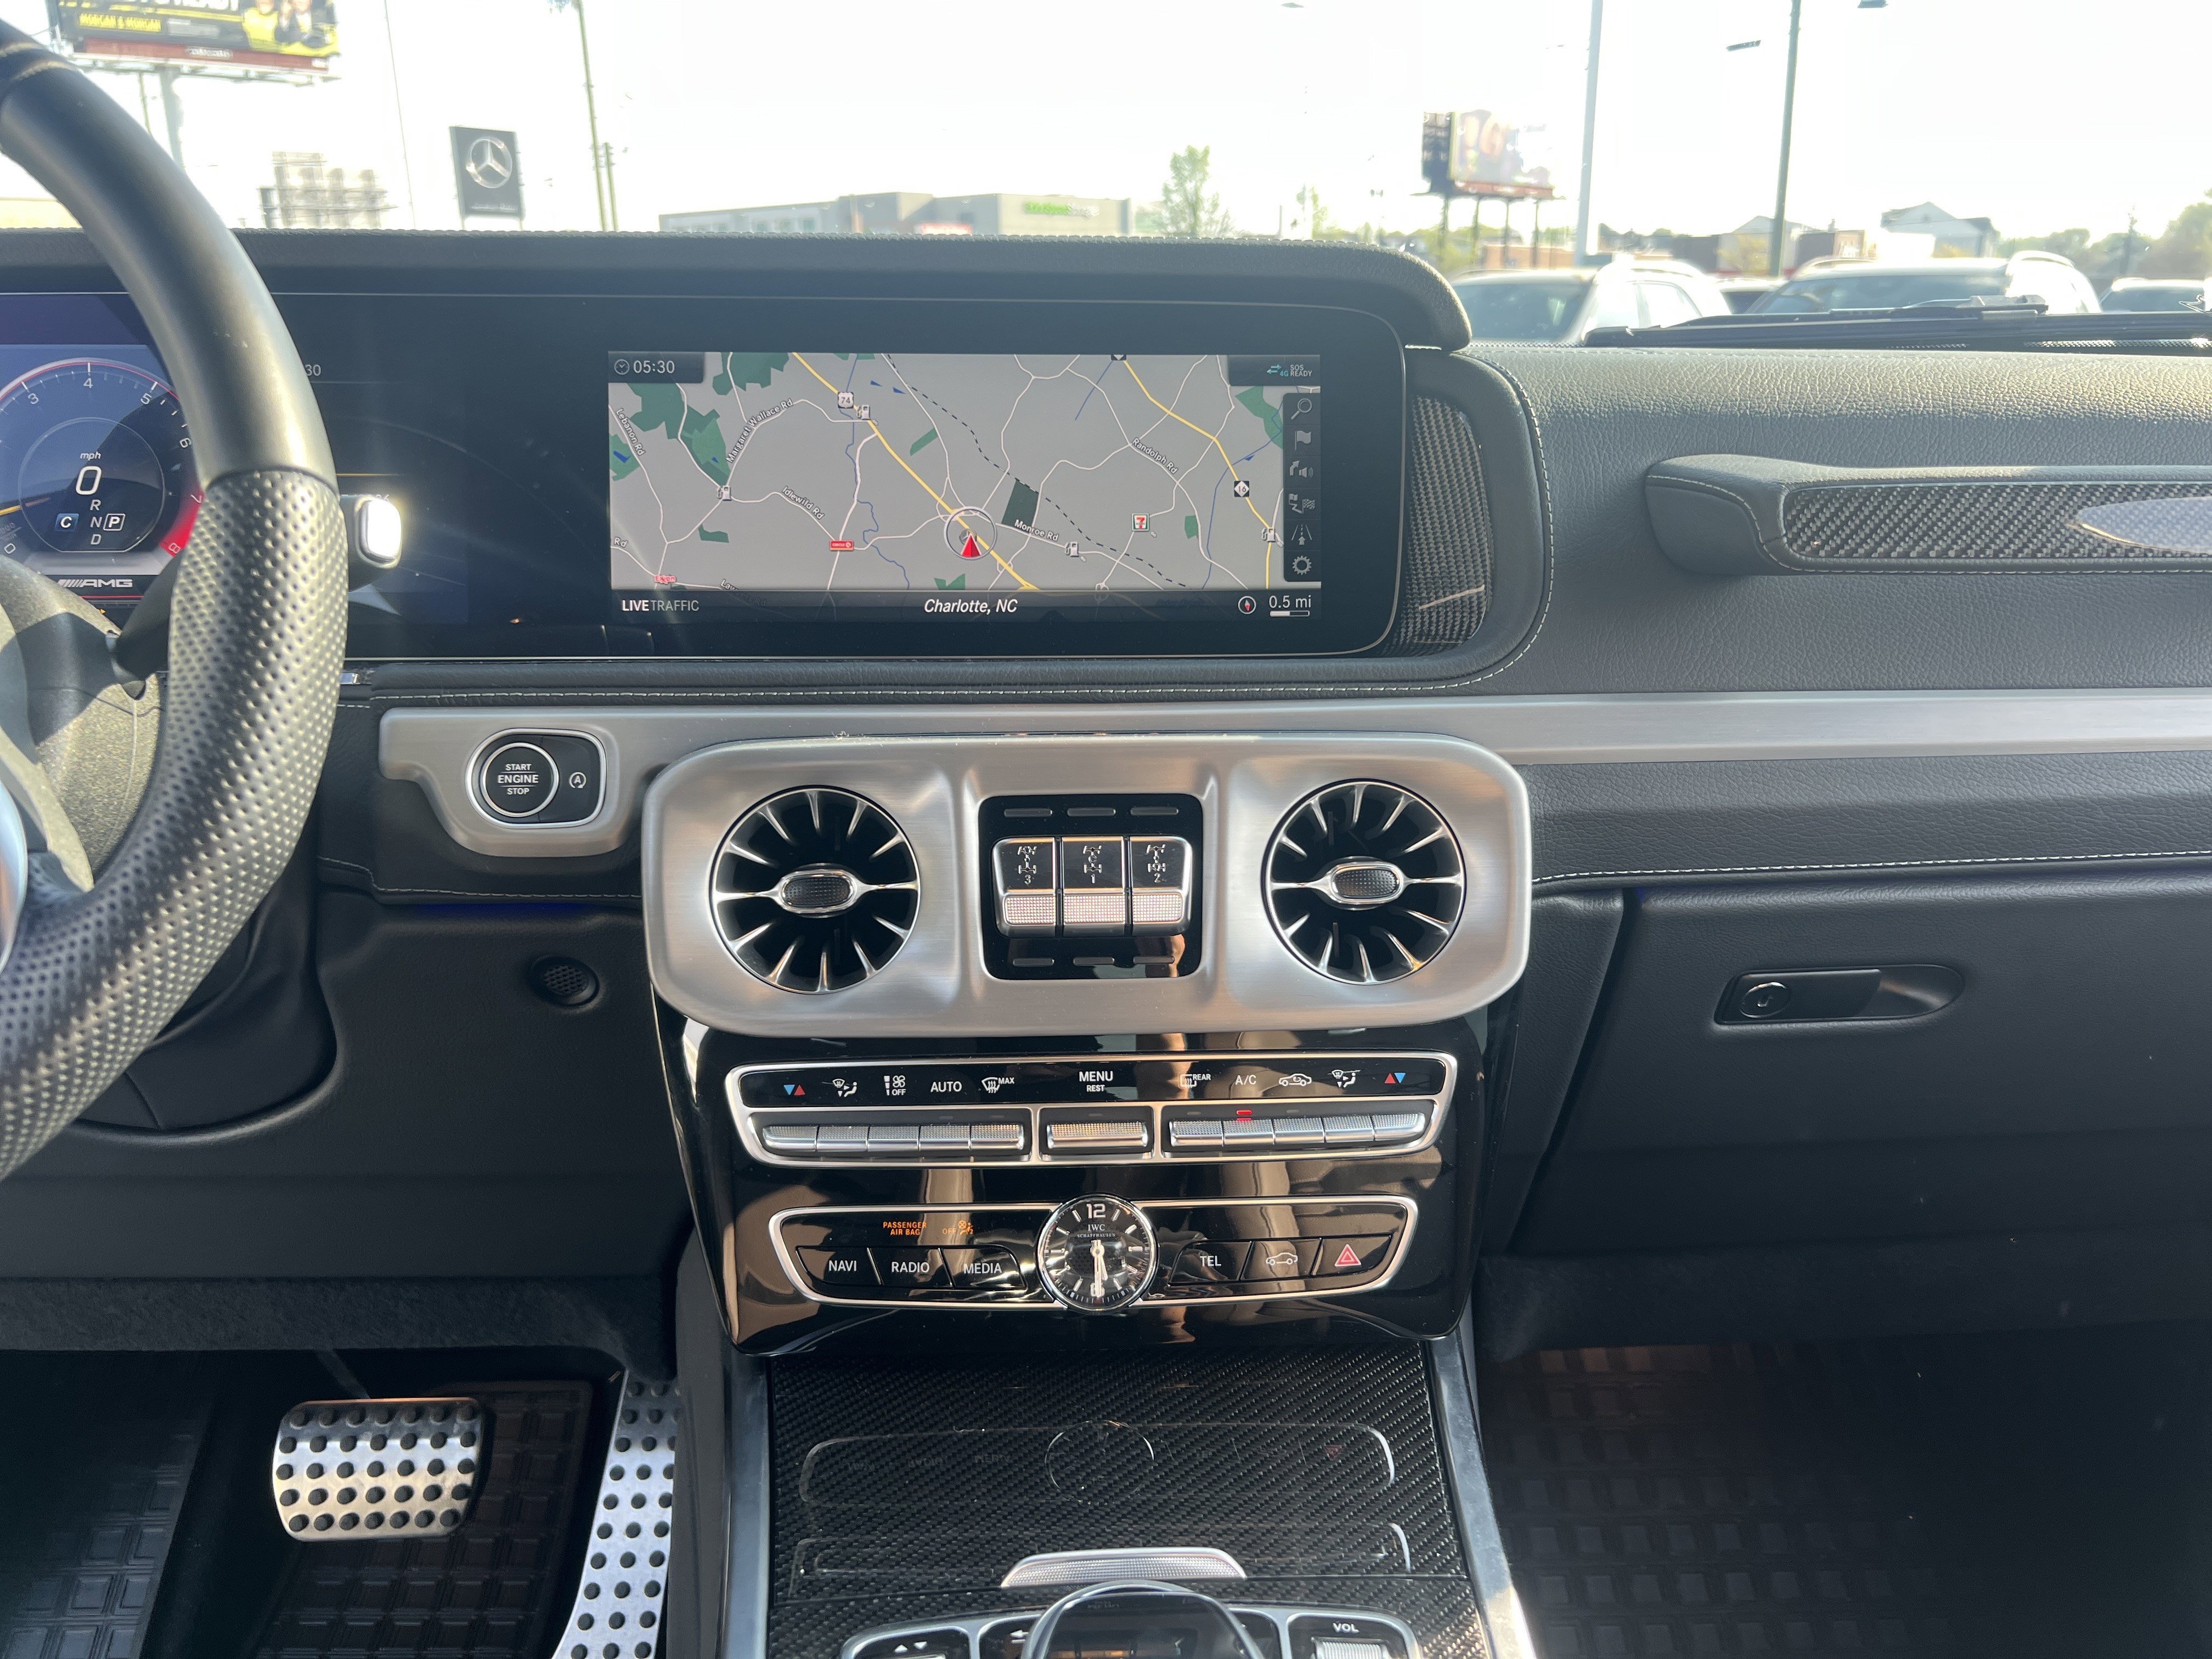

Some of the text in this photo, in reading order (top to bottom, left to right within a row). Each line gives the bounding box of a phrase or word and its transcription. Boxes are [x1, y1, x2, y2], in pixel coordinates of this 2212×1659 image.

[305, 364, 321, 376] 30
[634, 360, 675, 374] 05:30
[83, 377, 93, 388] 4
[27, 393, 39, 404] 3
[140, 393, 152, 405] 5
[616, 408, 645, 456] Lebanon Rd
[725, 398, 794, 463] Margaret Wallace Rd
[180, 437, 191, 448] 6
[80, 452, 101, 461] mph
[1132, 438, 1178, 475] Randolph Rd
[76, 466, 101, 495] 0
[1238, 485, 1246, 493] 16
[190, 494, 201, 503] 7
[781, 485, 825, 520] Idlewild Rd
[90, 500, 101, 510] R
[60, 517, 72, 528] C
[91, 517, 120, 527] N P
[1015, 520, 1059, 541] Monroe Rd
[91, 534, 101, 545] D
[614, 537, 628, 548] Rd
[4, 543, 15, 554] 0
[168, 543, 180, 554] 8
[82, 579, 133, 588] AMG
[623, 600, 699, 611] LIVE TRAFFIC
[924, 599, 1018, 614] Charlotte, NC
[1269, 595, 1311, 608] 0.5 mi
[497, 775, 539, 783] ENGINE
[1024, 874, 1031, 884] 3
[1091, 873, 1096, 884] 1
[1154, 873, 1161, 883] 2
[930, 1081, 962, 1093] AUTO
[1079, 1071, 1113, 1082] MENU
[1235, 1075, 1256, 1085] A/C
[1086, 1204, 1106, 1218] 12
[828, 1256, 1221, 1274] NAVI RADIO MEDIA TEL
[1333, 1622, 1359, 1633] VOL
